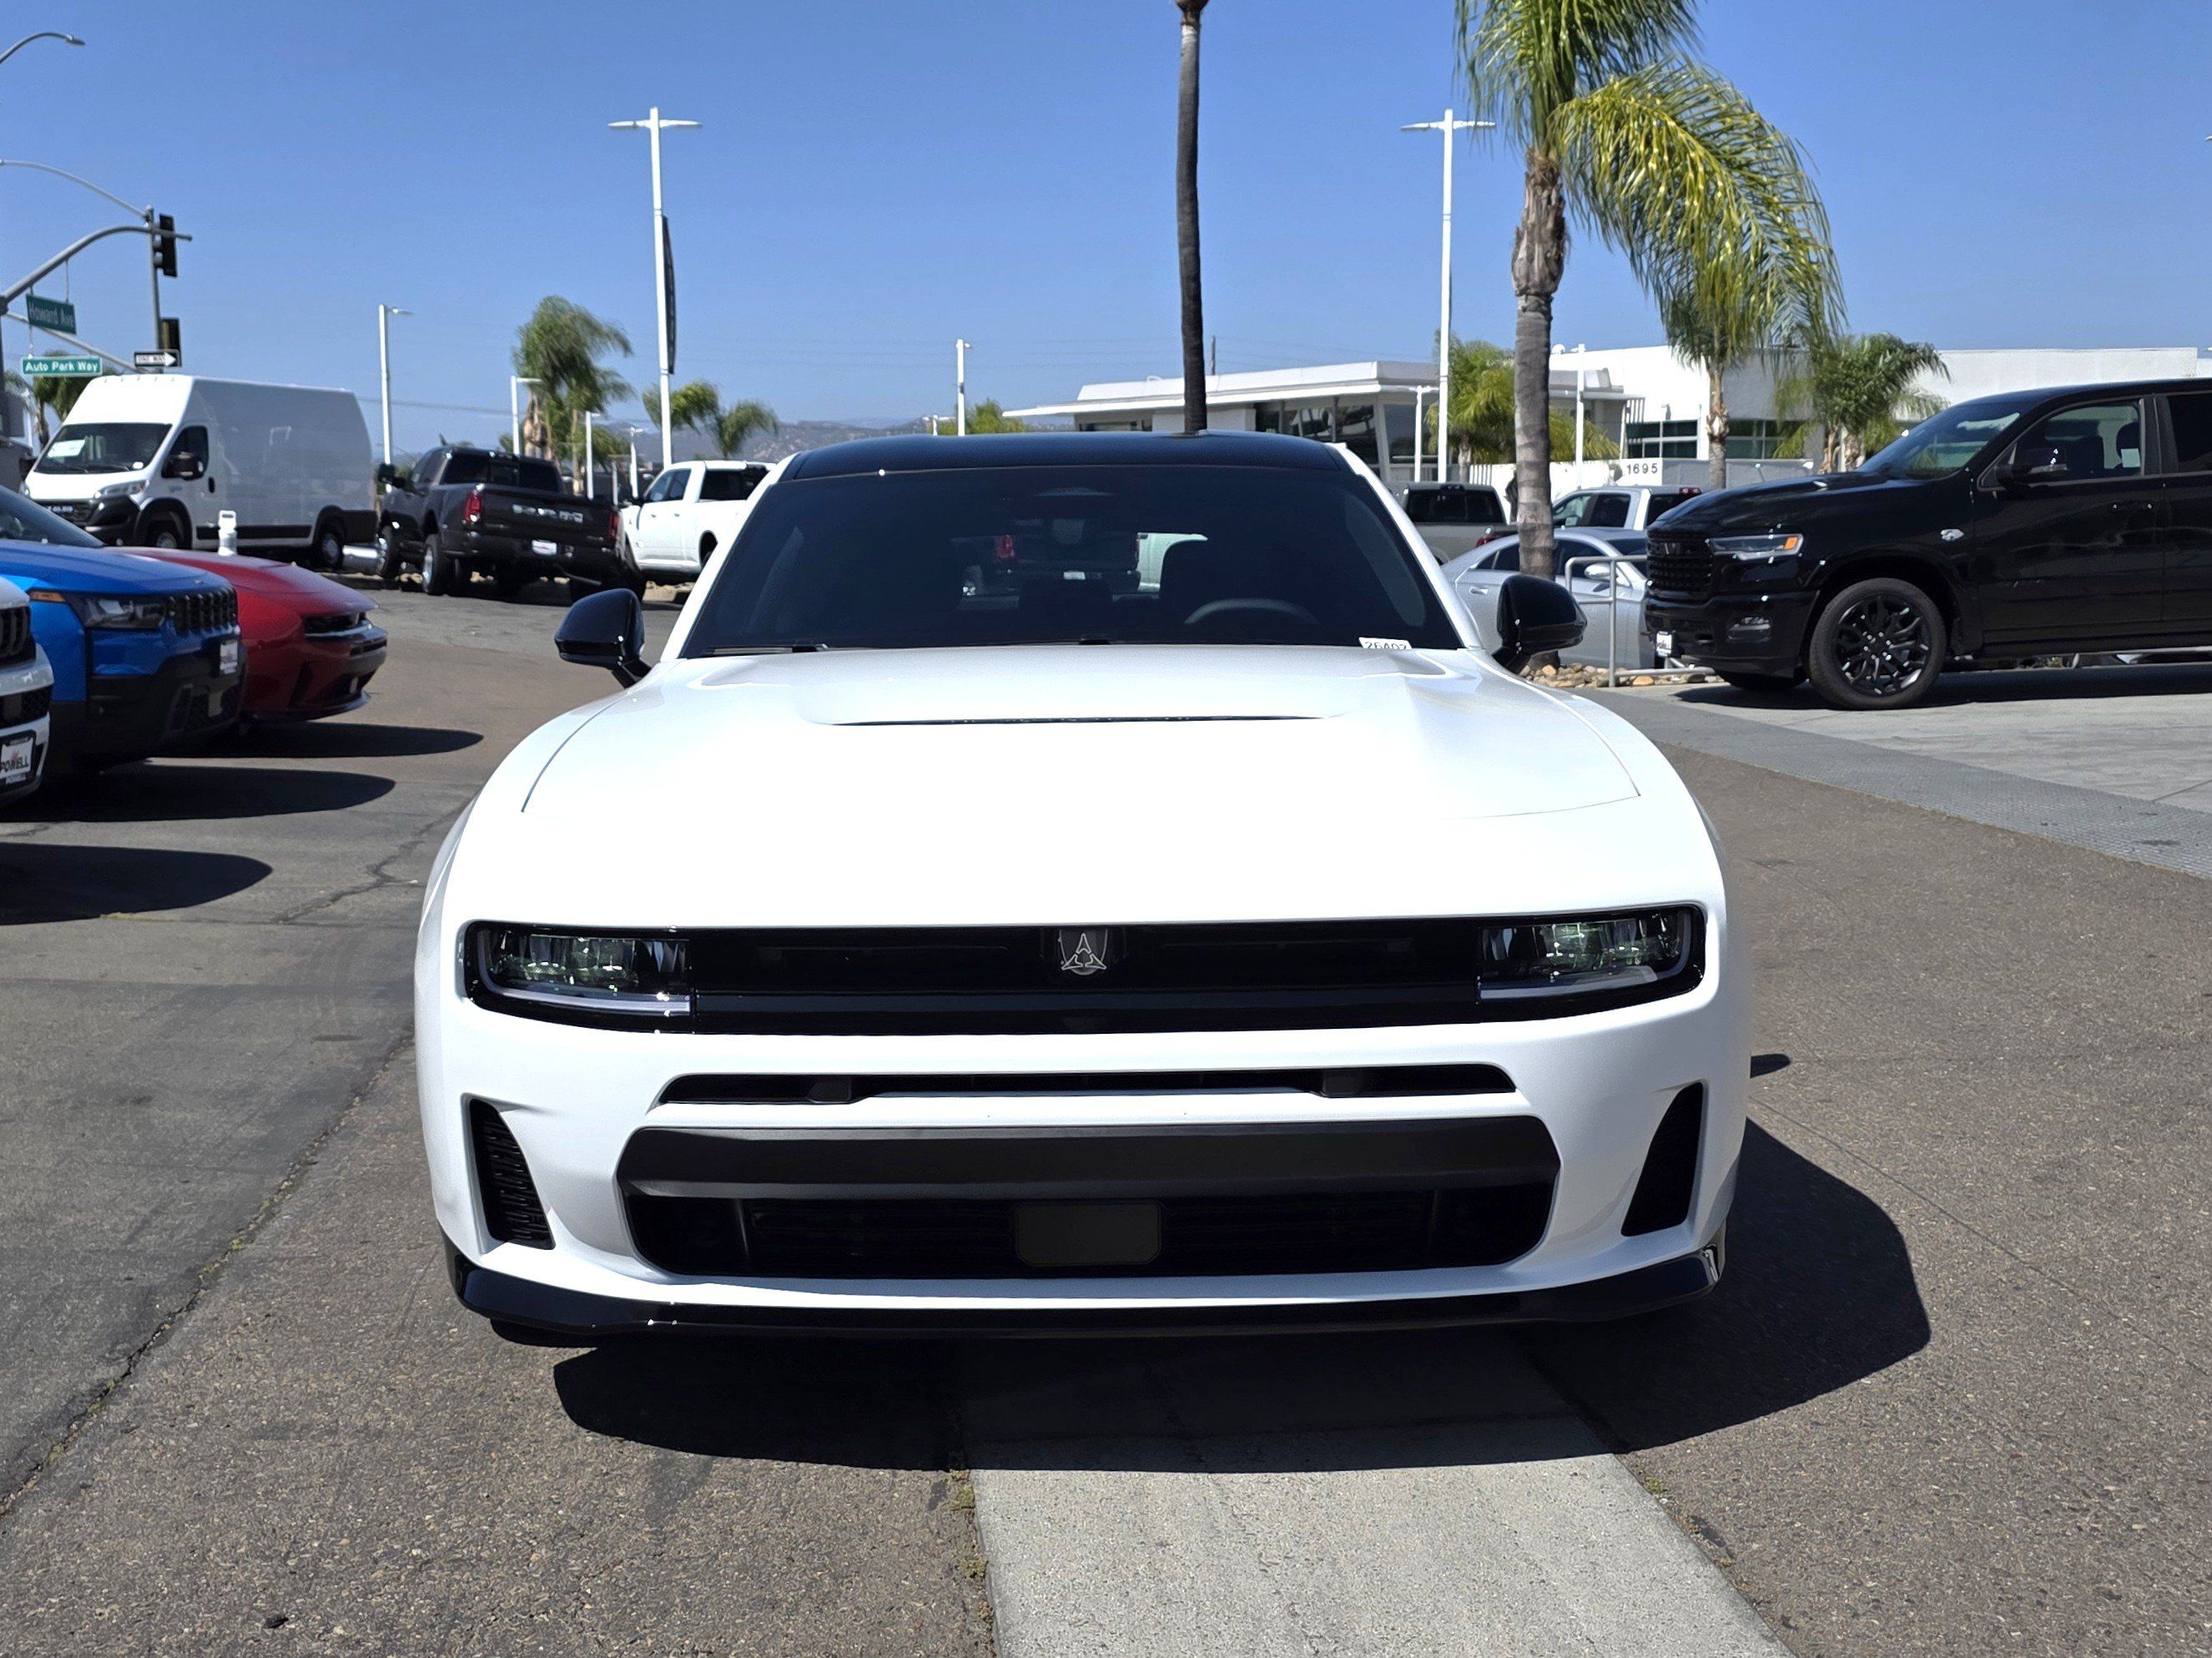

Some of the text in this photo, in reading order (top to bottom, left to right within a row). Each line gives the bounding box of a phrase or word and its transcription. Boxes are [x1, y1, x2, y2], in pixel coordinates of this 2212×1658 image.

[25, 361, 98, 373] Auto Park Way
[1626, 462, 1658, 475] 1695
